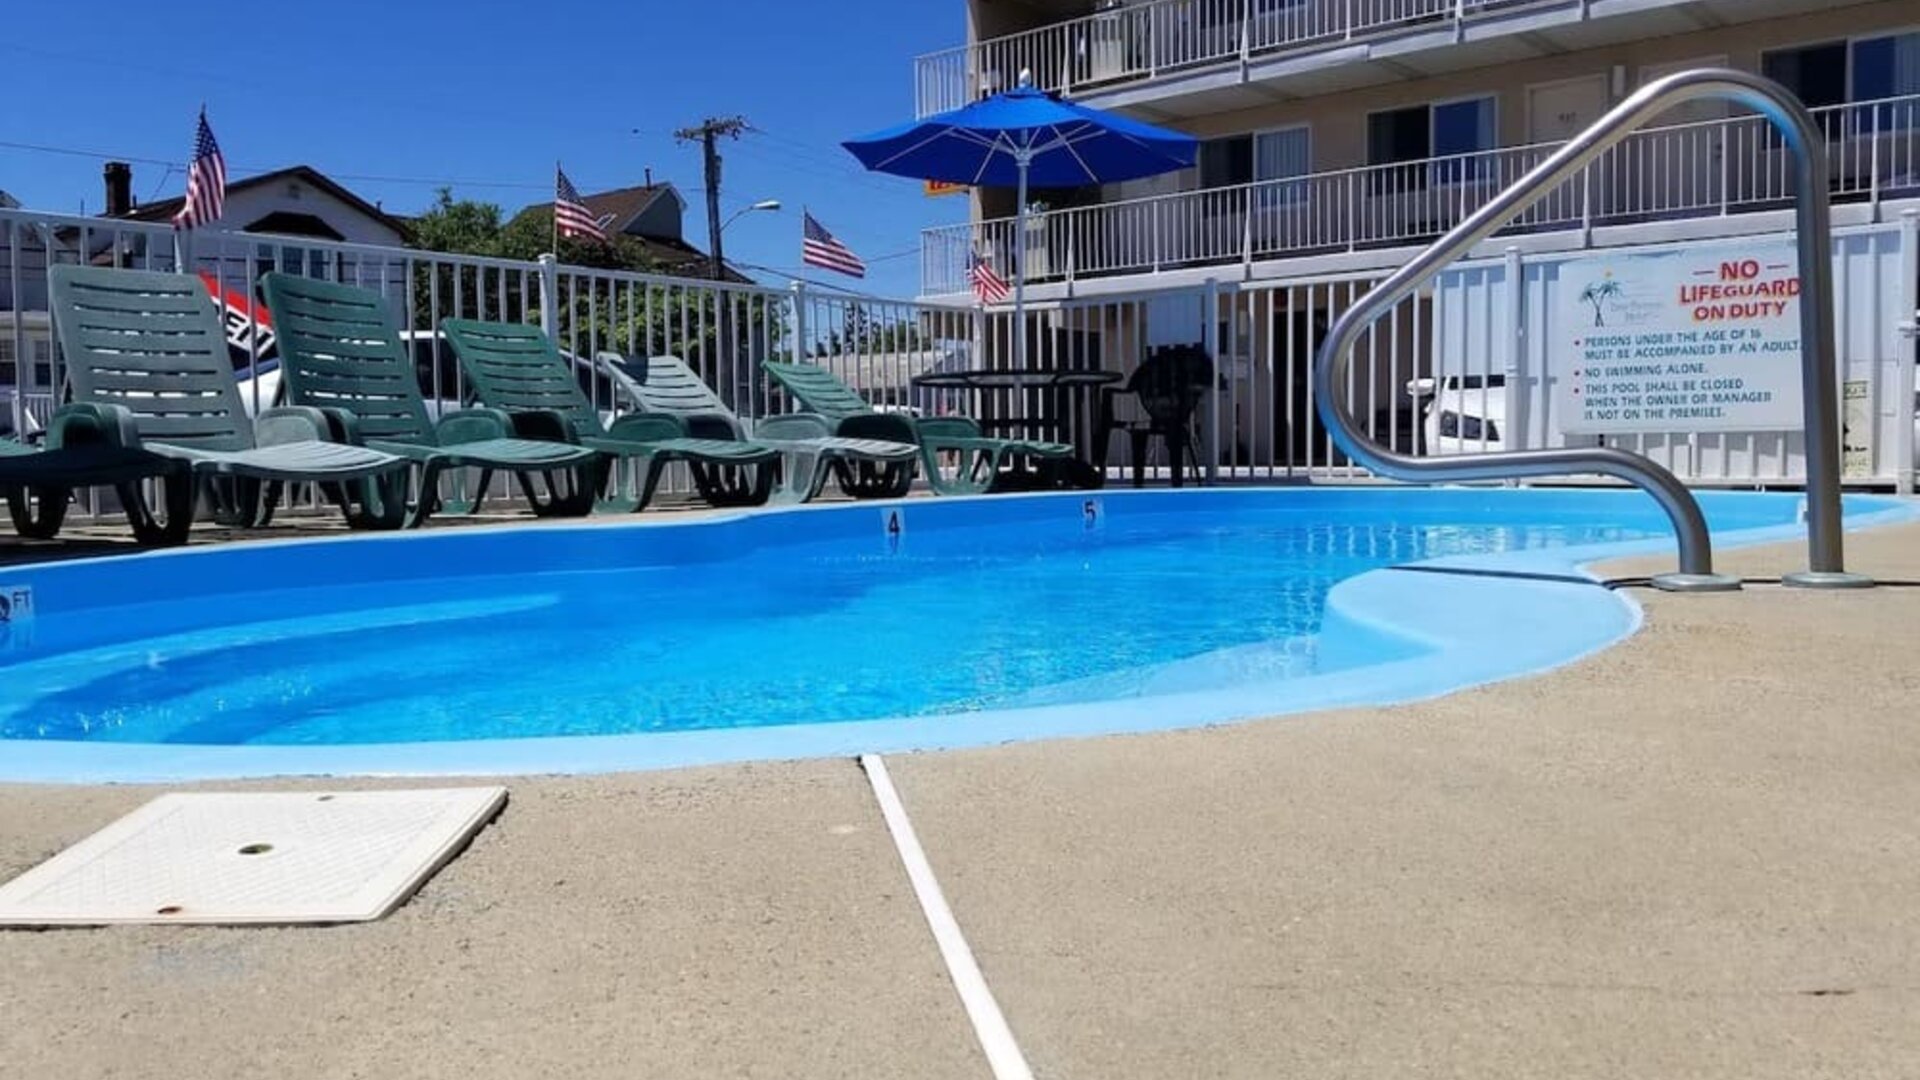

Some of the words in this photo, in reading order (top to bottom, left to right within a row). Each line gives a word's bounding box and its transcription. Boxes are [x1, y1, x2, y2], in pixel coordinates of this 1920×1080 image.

[1720, 260, 1760, 281] NO
[1681, 278, 1801, 303] LIFEGUARD
[1694, 307, 1726, 322] ON
[1729, 301, 1787, 320] DUTY
[1585, 336, 1631, 347] PERSONS
[1635, 334, 1673, 345] UNDER
[1677, 332, 1698, 342] THE
[1703, 330, 1727, 341] AGE
[1730, 329, 1745, 339] OF
[1585, 349, 1613, 359] MUST
[1617, 348, 1630, 358] BE
[1634, 345, 1716, 357] ACCOMPANIED
[1720, 343, 1734, 354] BY
[1739, 342, 1757, 352] AN
[1585, 367, 1600, 377] NO
[1605, 364, 1662, 376] SWIMMING
[1666, 362, 1709, 374] ALONE.
[1586, 383, 1608, 394] THIS
[1612, 382, 1640, 393] POOL
[1645, 380, 1678, 392] SHALL
[1683, 380, 1697, 390] BE
[1701, 378, 1745, 389] CLOSED
[1585, 397, 1618, 407] WHEN
[1621, 395, 1642, 405] THE
[1646, 394, 1688, 405] OWNER
[1692, 393, 1708, 403] OR
[1712, 391, 1772, 402] MANAGER
[1585, 410, 1593, 419] IS
[1597, 409, 1619, 419] NOT
[1624, 408, 1640, 418] ON
[1644, 408, 1664, 418] THE
[1669, 406, 1727, 418] PREMISES.
[1085, 501, 1096, 521] 5
[888, 511, 899, 533] 4
